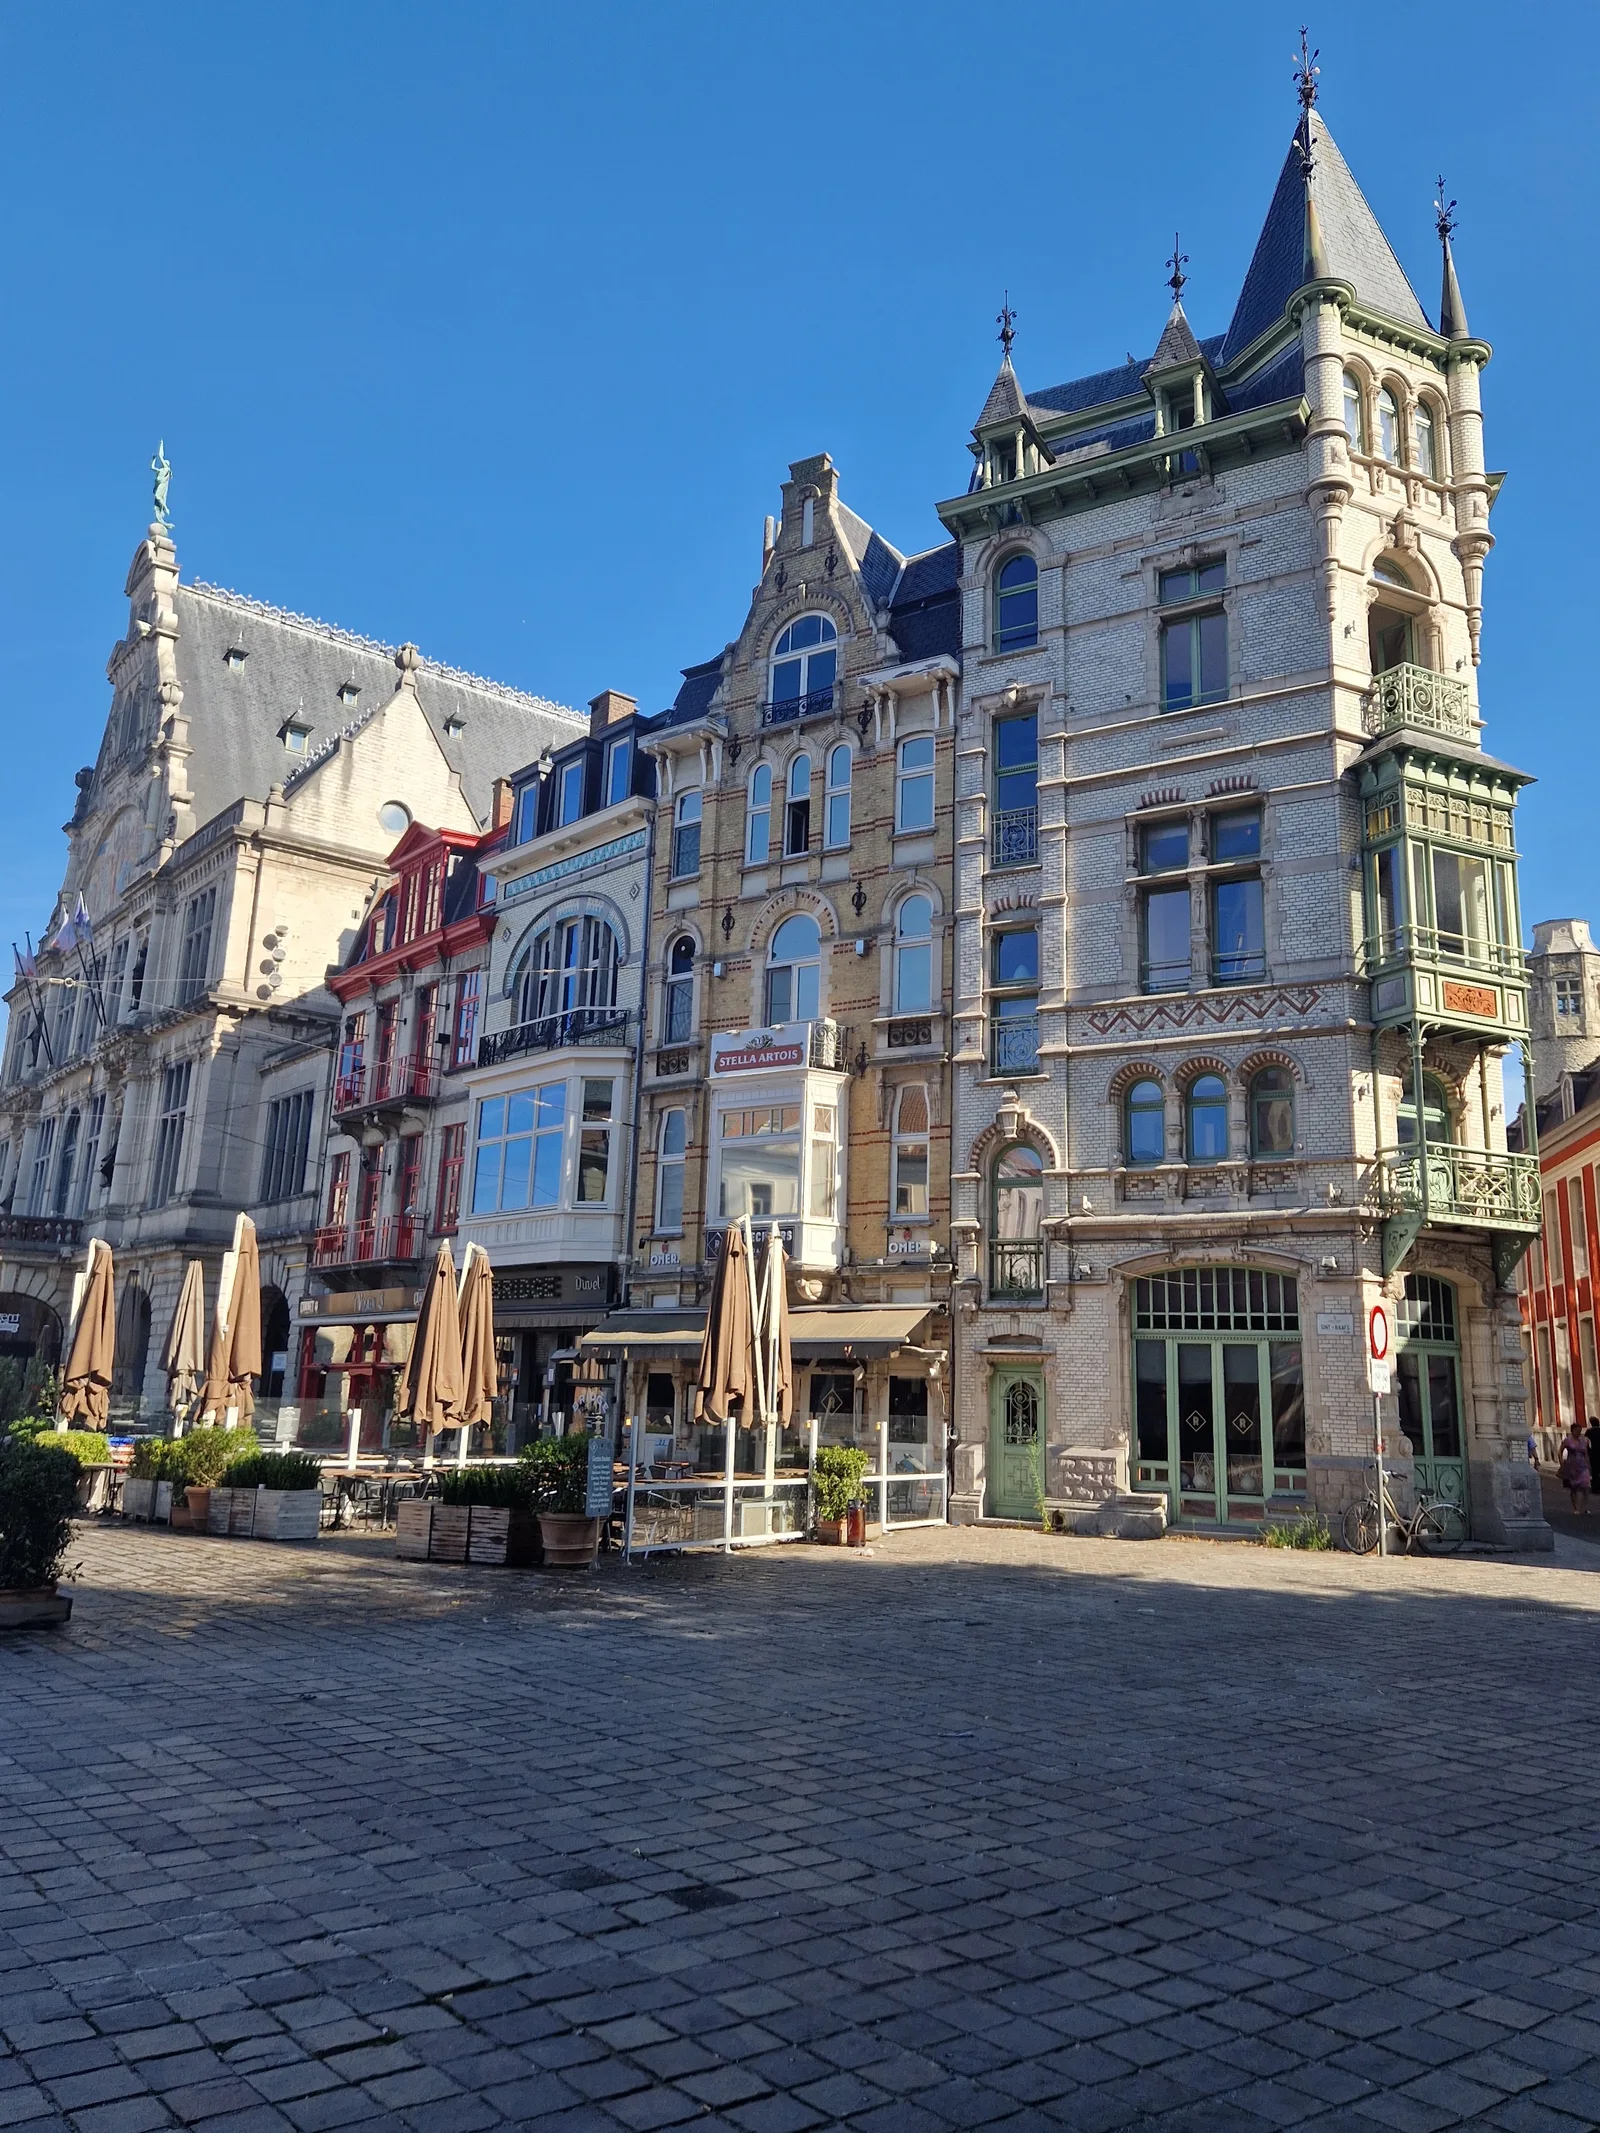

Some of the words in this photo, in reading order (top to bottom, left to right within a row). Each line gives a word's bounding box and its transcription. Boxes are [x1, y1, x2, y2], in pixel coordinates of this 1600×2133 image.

[719, 1055, 757, 1067] STELLA
[758, 1049, 798, 1062] ARTOIS
[575, 1276, 600, 1290] Duvel
[1192, 1416, 1199, 1426] R
[1239, 1418, 1246, 1428] R
